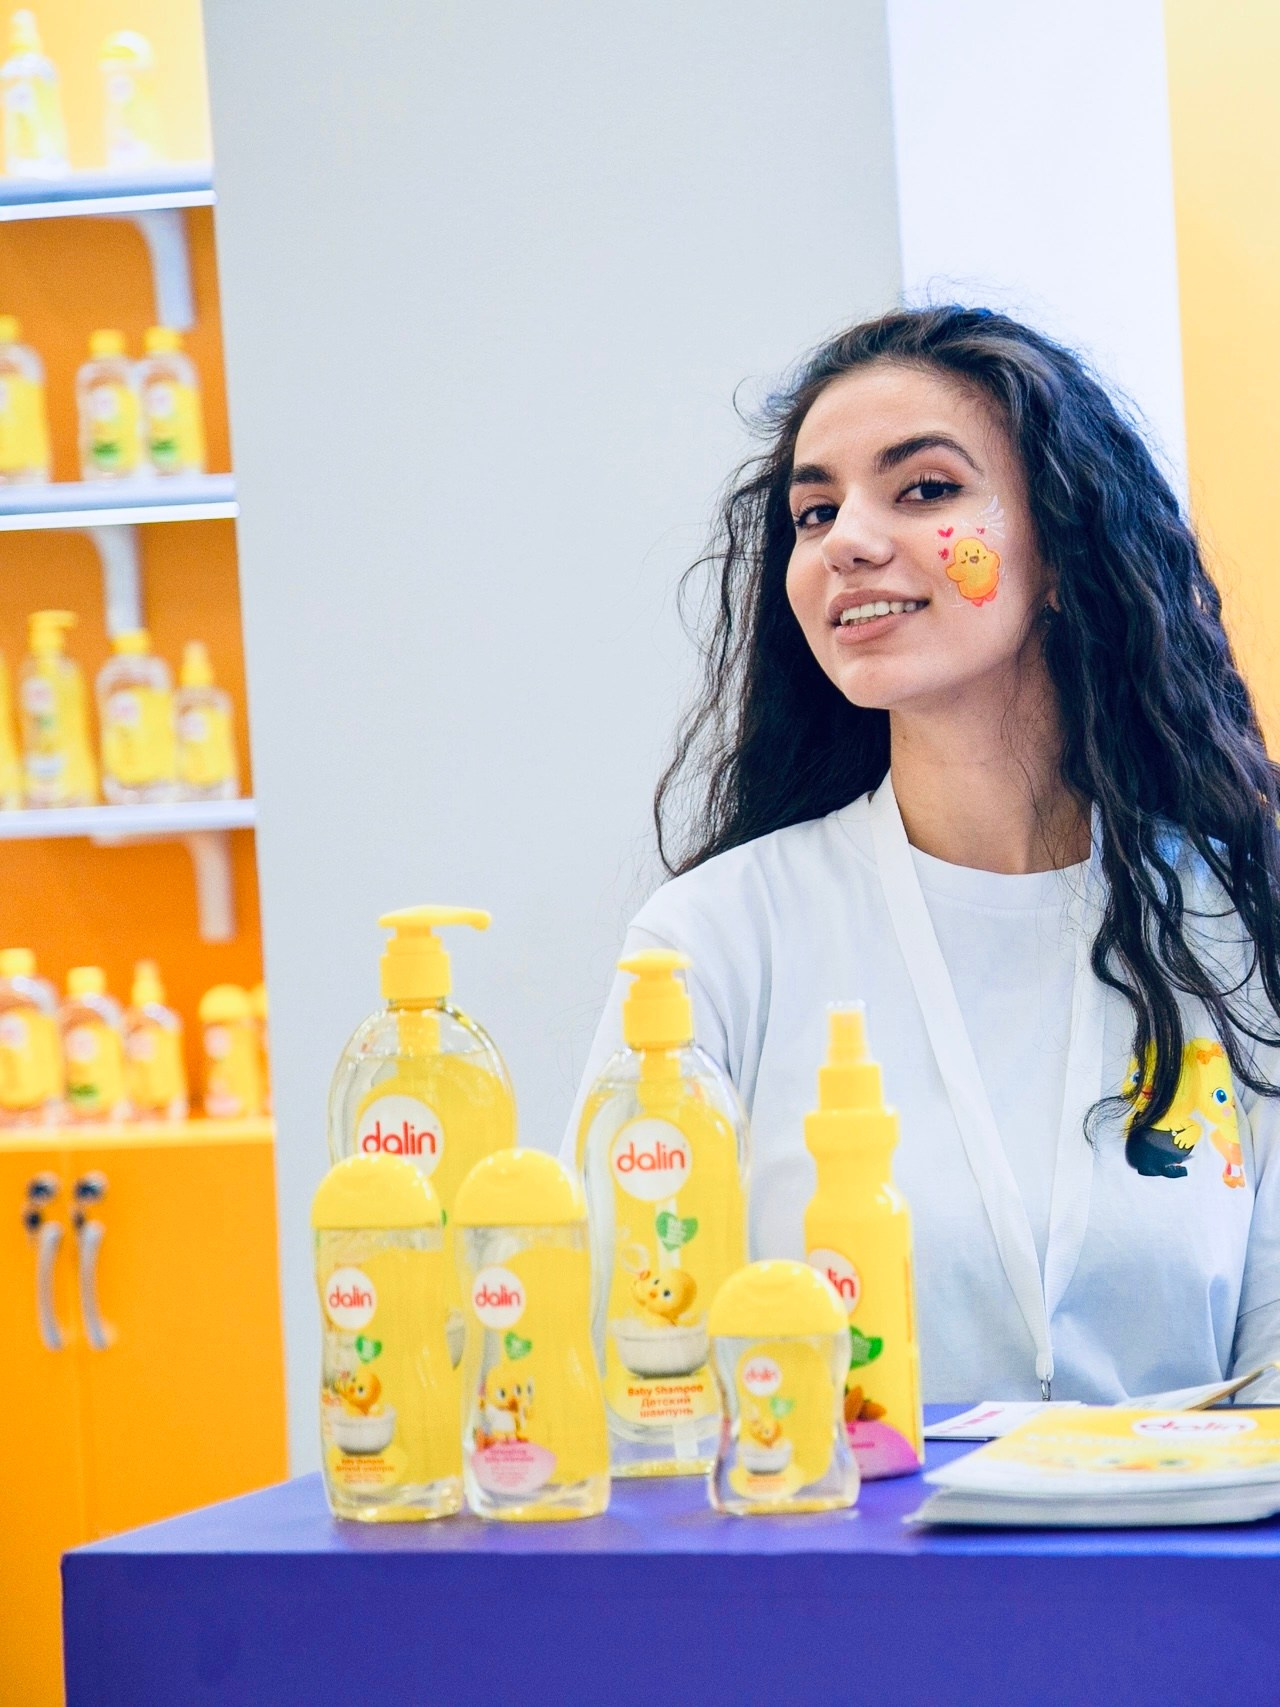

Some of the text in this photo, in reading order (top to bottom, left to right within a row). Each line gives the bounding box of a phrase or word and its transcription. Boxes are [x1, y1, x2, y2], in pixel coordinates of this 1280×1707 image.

[362, 1121, 437, 1156] dalin
[616, 1141, 686, 1173] dalin
[328, 1285, 372, 1308] dalin
[474, 1285, 520, 1308] dalin
[627, 1384, 703, 1398] Baby Shampoo
